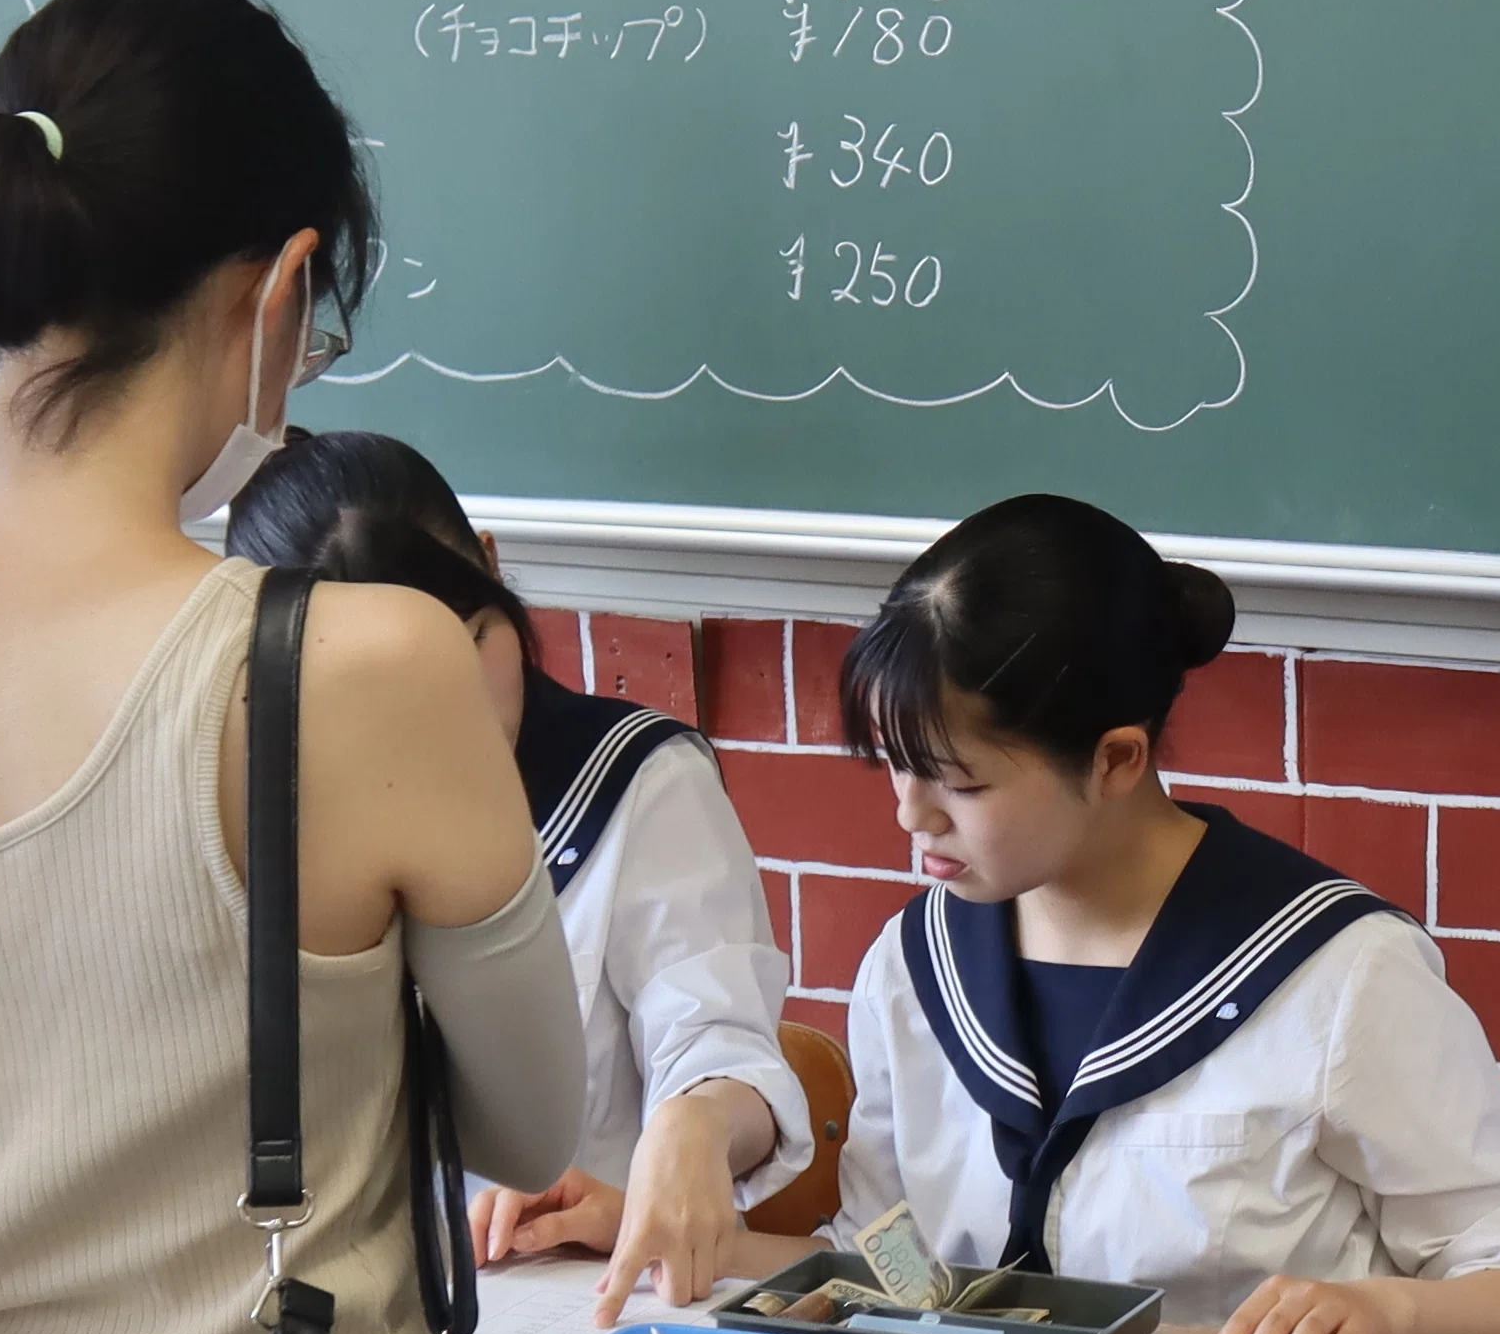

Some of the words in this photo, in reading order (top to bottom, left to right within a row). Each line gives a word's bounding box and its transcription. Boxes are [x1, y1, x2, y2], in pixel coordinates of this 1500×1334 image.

[783, 3, 952, 65] ¥180
[777, 114, 952, 189] ¥340
[779, 234, 941, 307] ¥250
